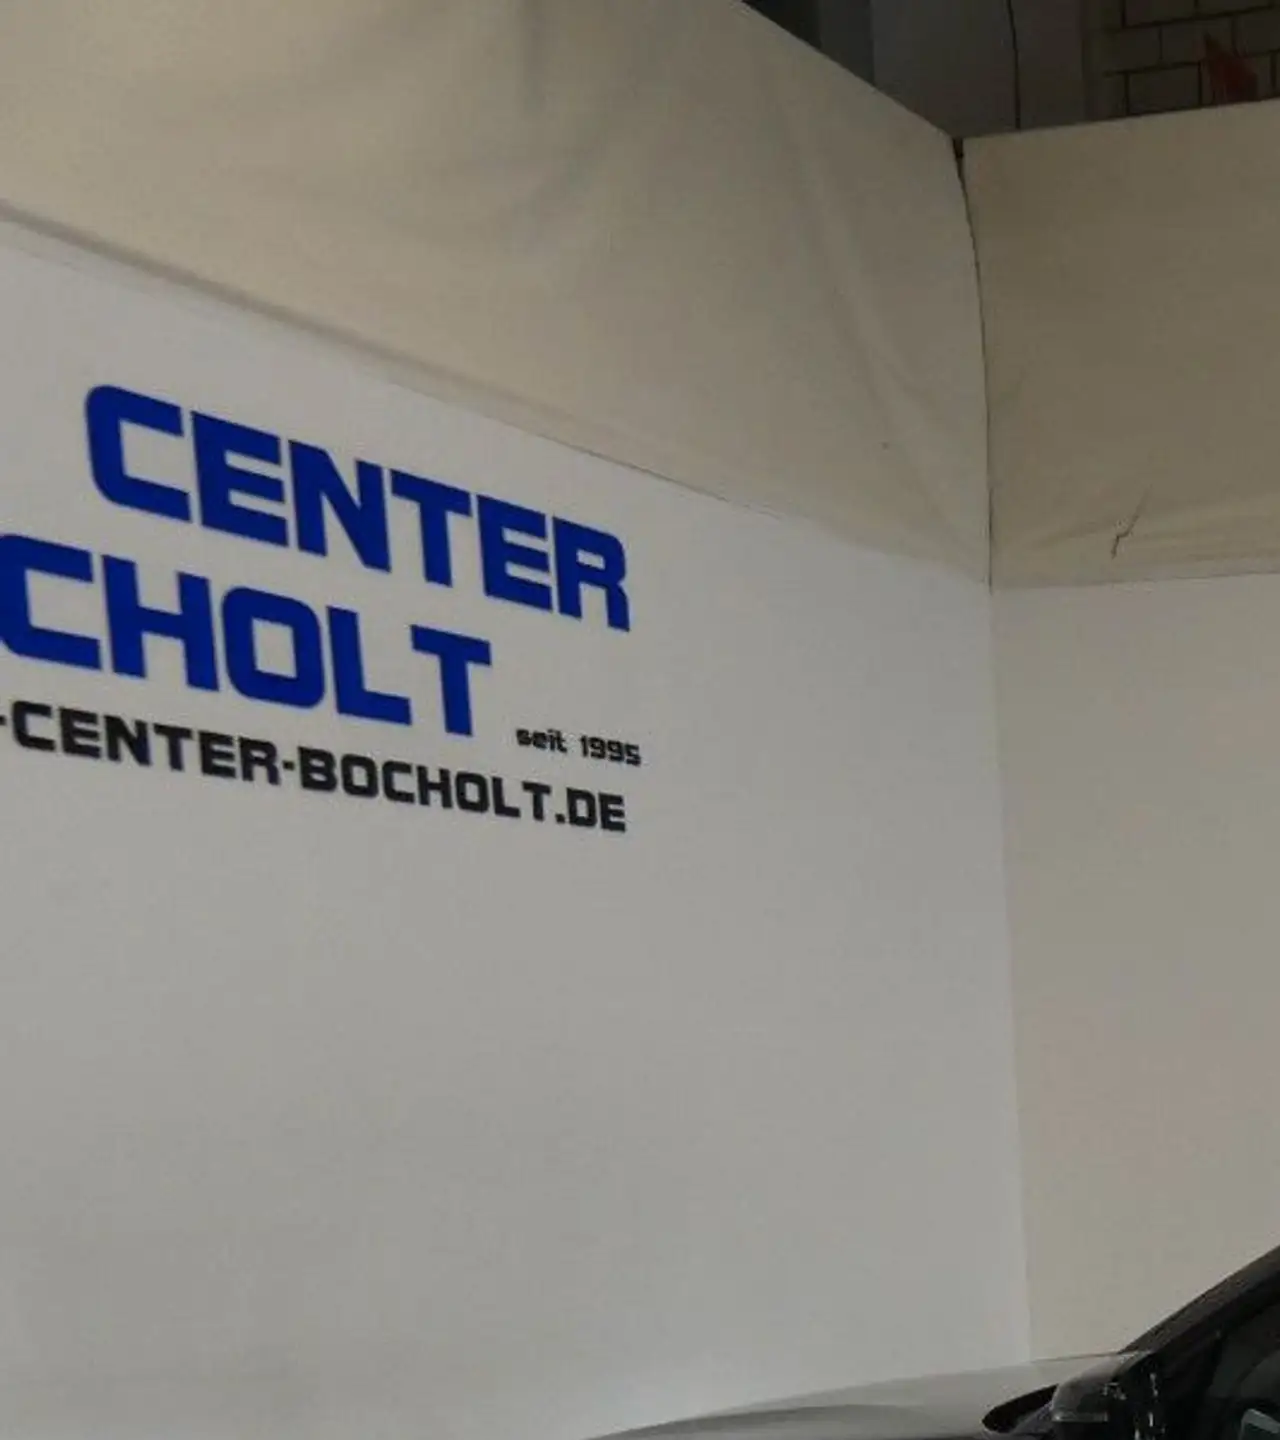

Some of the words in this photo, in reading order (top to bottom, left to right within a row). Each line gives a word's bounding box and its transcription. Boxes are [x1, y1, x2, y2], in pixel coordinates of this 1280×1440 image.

[85, 384, 632, 633] CENTER
[0, 533, 493, 738] CHOLT
[515, 727, 567, 755] seit
[578, 735, 642, 768] 1995
